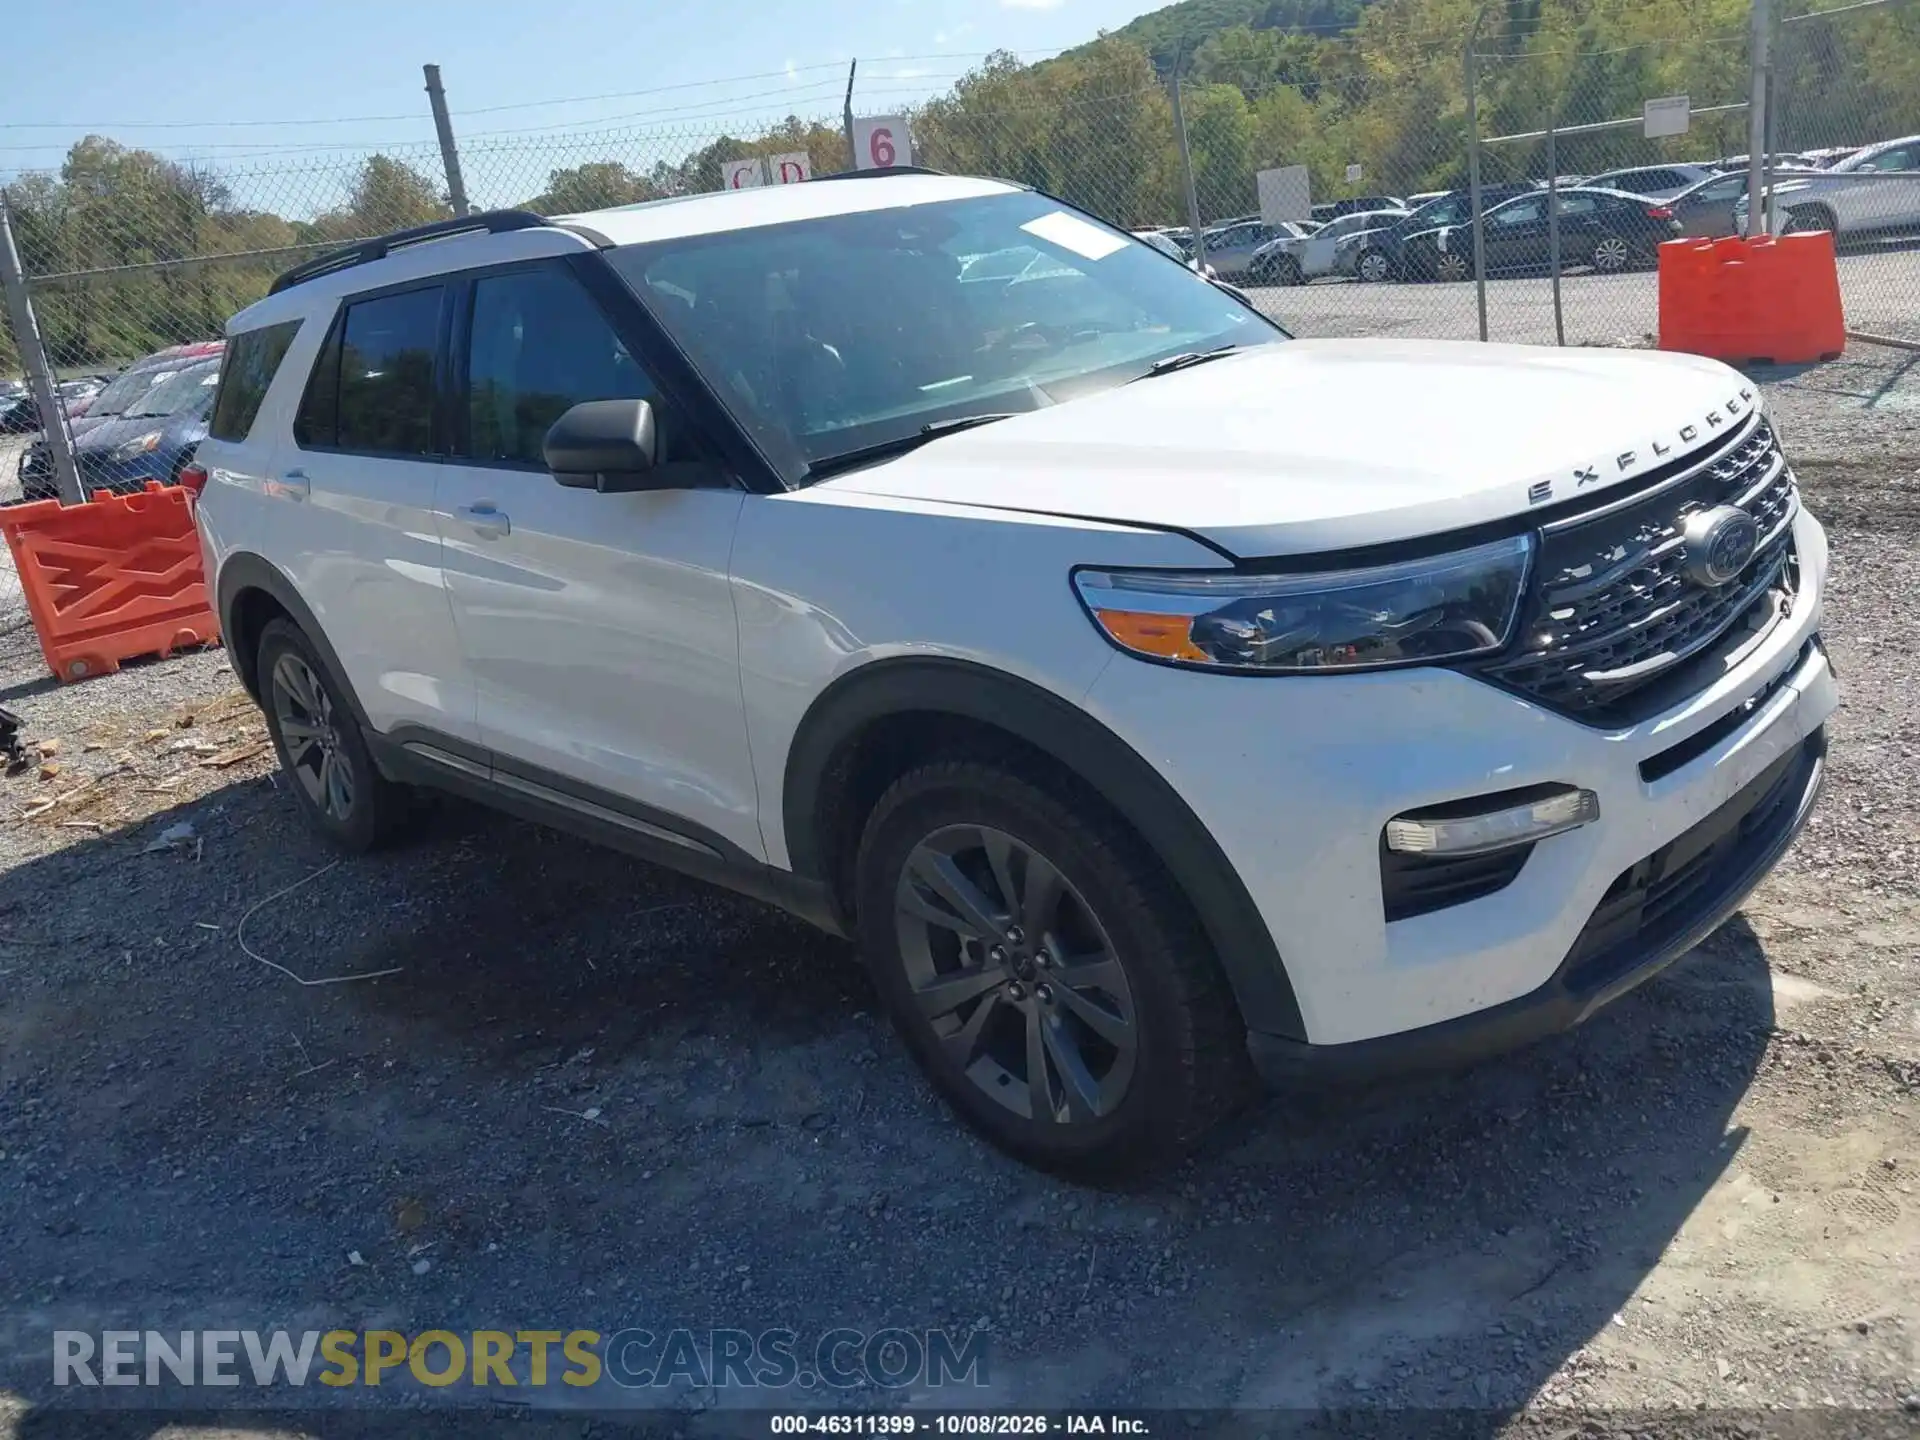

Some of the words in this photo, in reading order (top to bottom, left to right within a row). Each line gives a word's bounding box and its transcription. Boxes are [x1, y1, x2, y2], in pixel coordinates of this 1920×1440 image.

[870, 128, 896, 167] 6
[780, 162, 804, 184] D
[1528, 388, 1753, 505] EXPLORER
